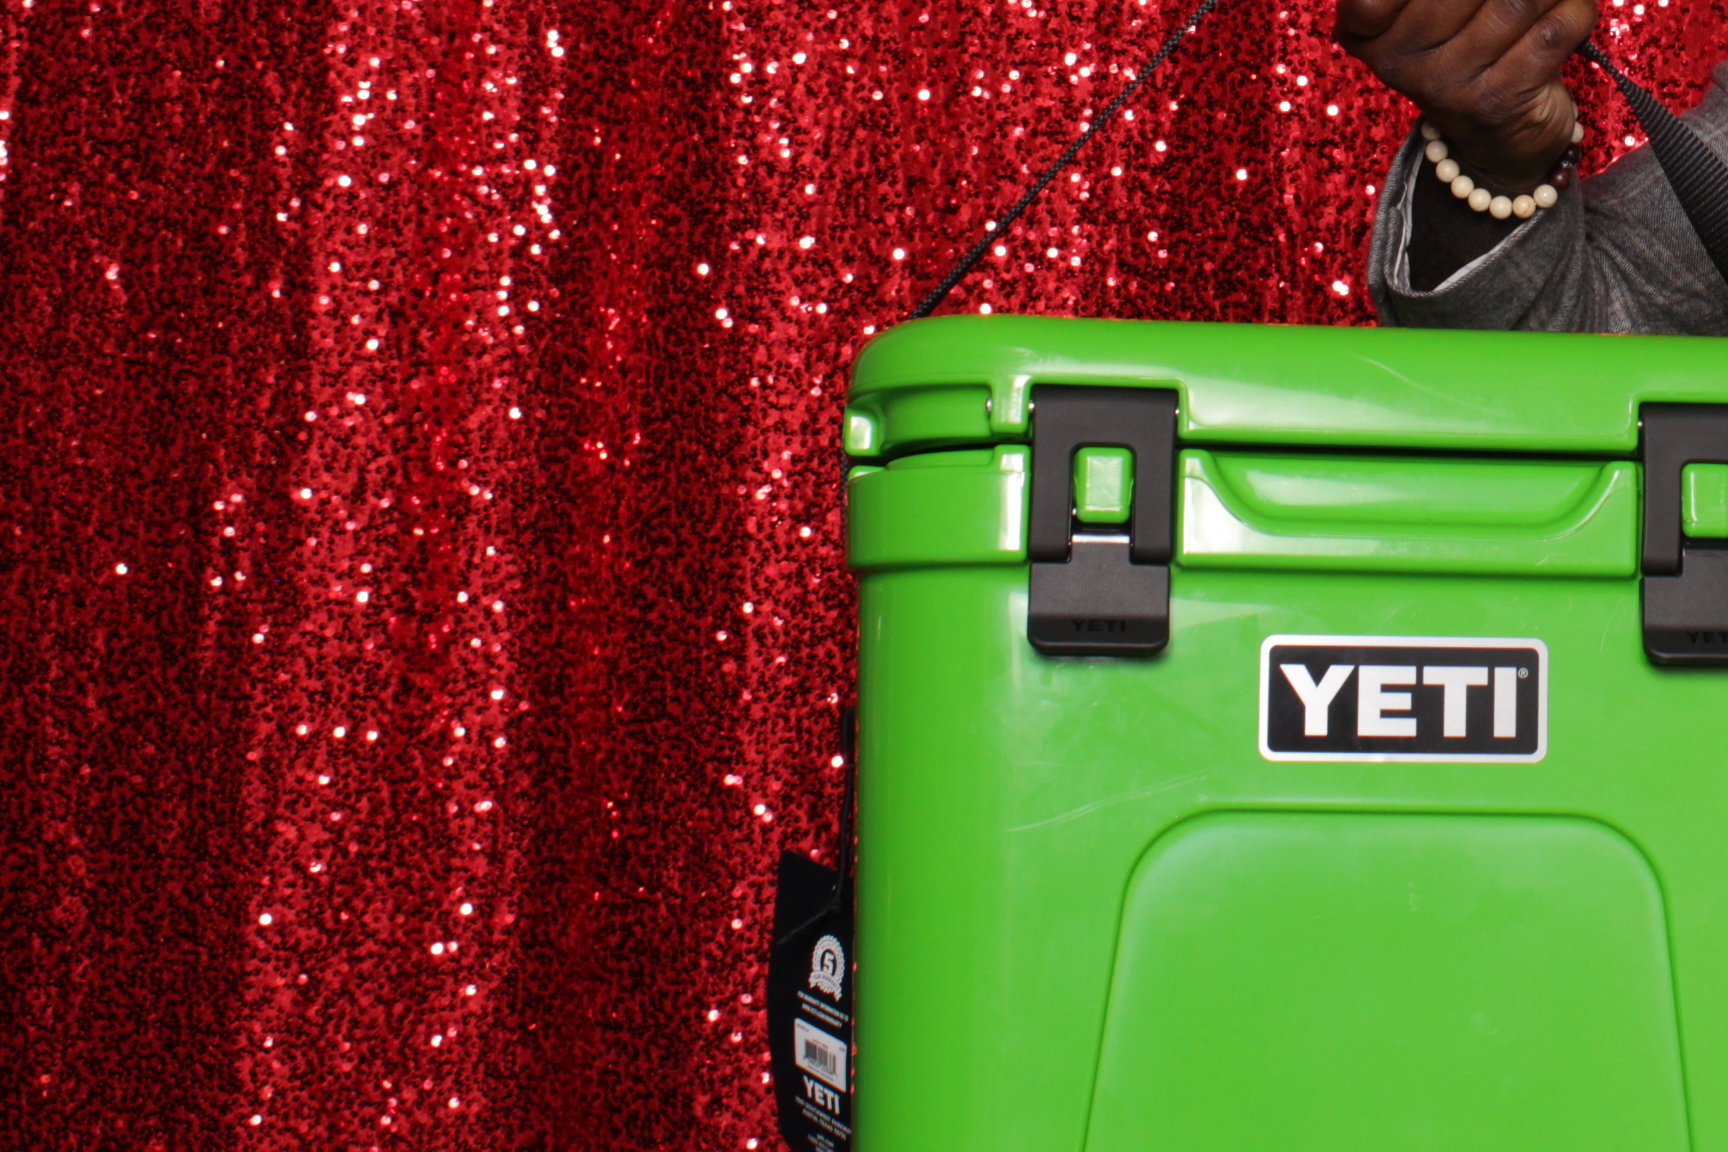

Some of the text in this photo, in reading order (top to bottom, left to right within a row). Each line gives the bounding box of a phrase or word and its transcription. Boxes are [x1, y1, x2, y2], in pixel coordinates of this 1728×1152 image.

[1071, 619, 1126, 632] YETI
[822, 951, 835, 976] 5
[803, 1075, 840, 1115] YETI
